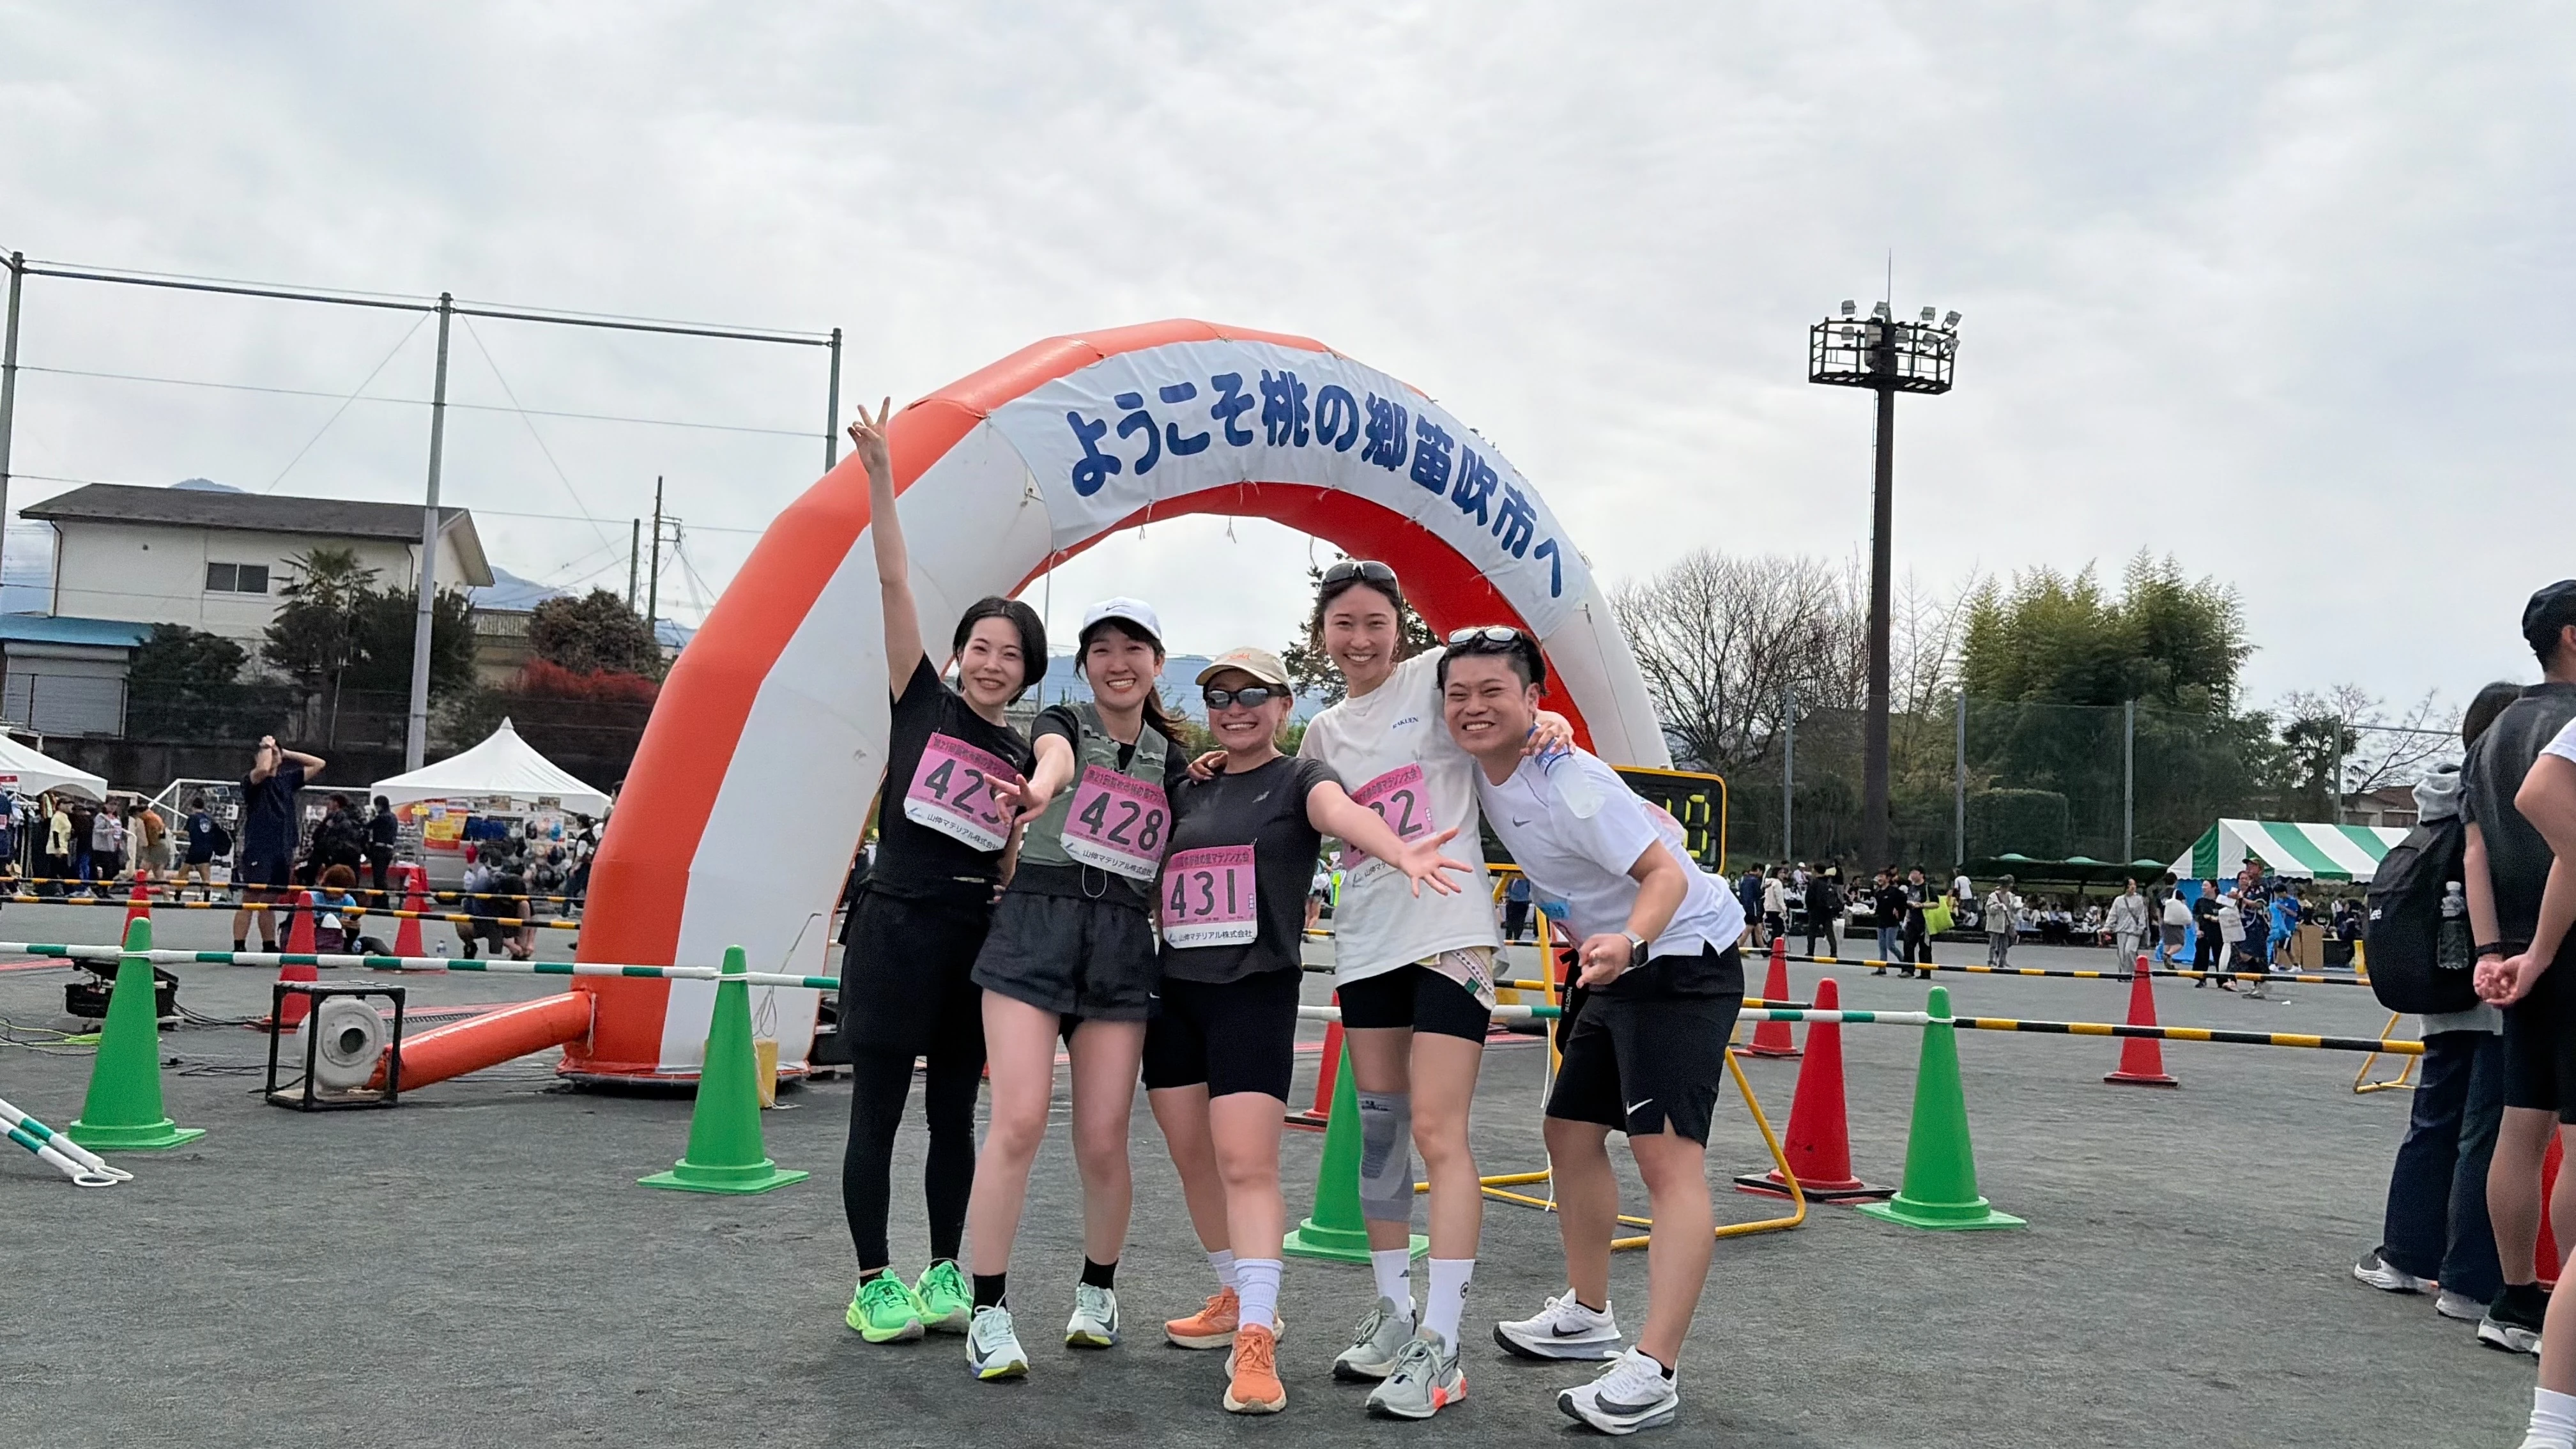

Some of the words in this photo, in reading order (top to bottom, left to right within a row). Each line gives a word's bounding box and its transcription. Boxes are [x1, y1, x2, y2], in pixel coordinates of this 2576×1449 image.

[1067, 369, 1561, 599] ようこそ桃の郷笛吹市へ
[1079, 792, 1163, 850] 428
[1170, 869, 1236, 918] 431
